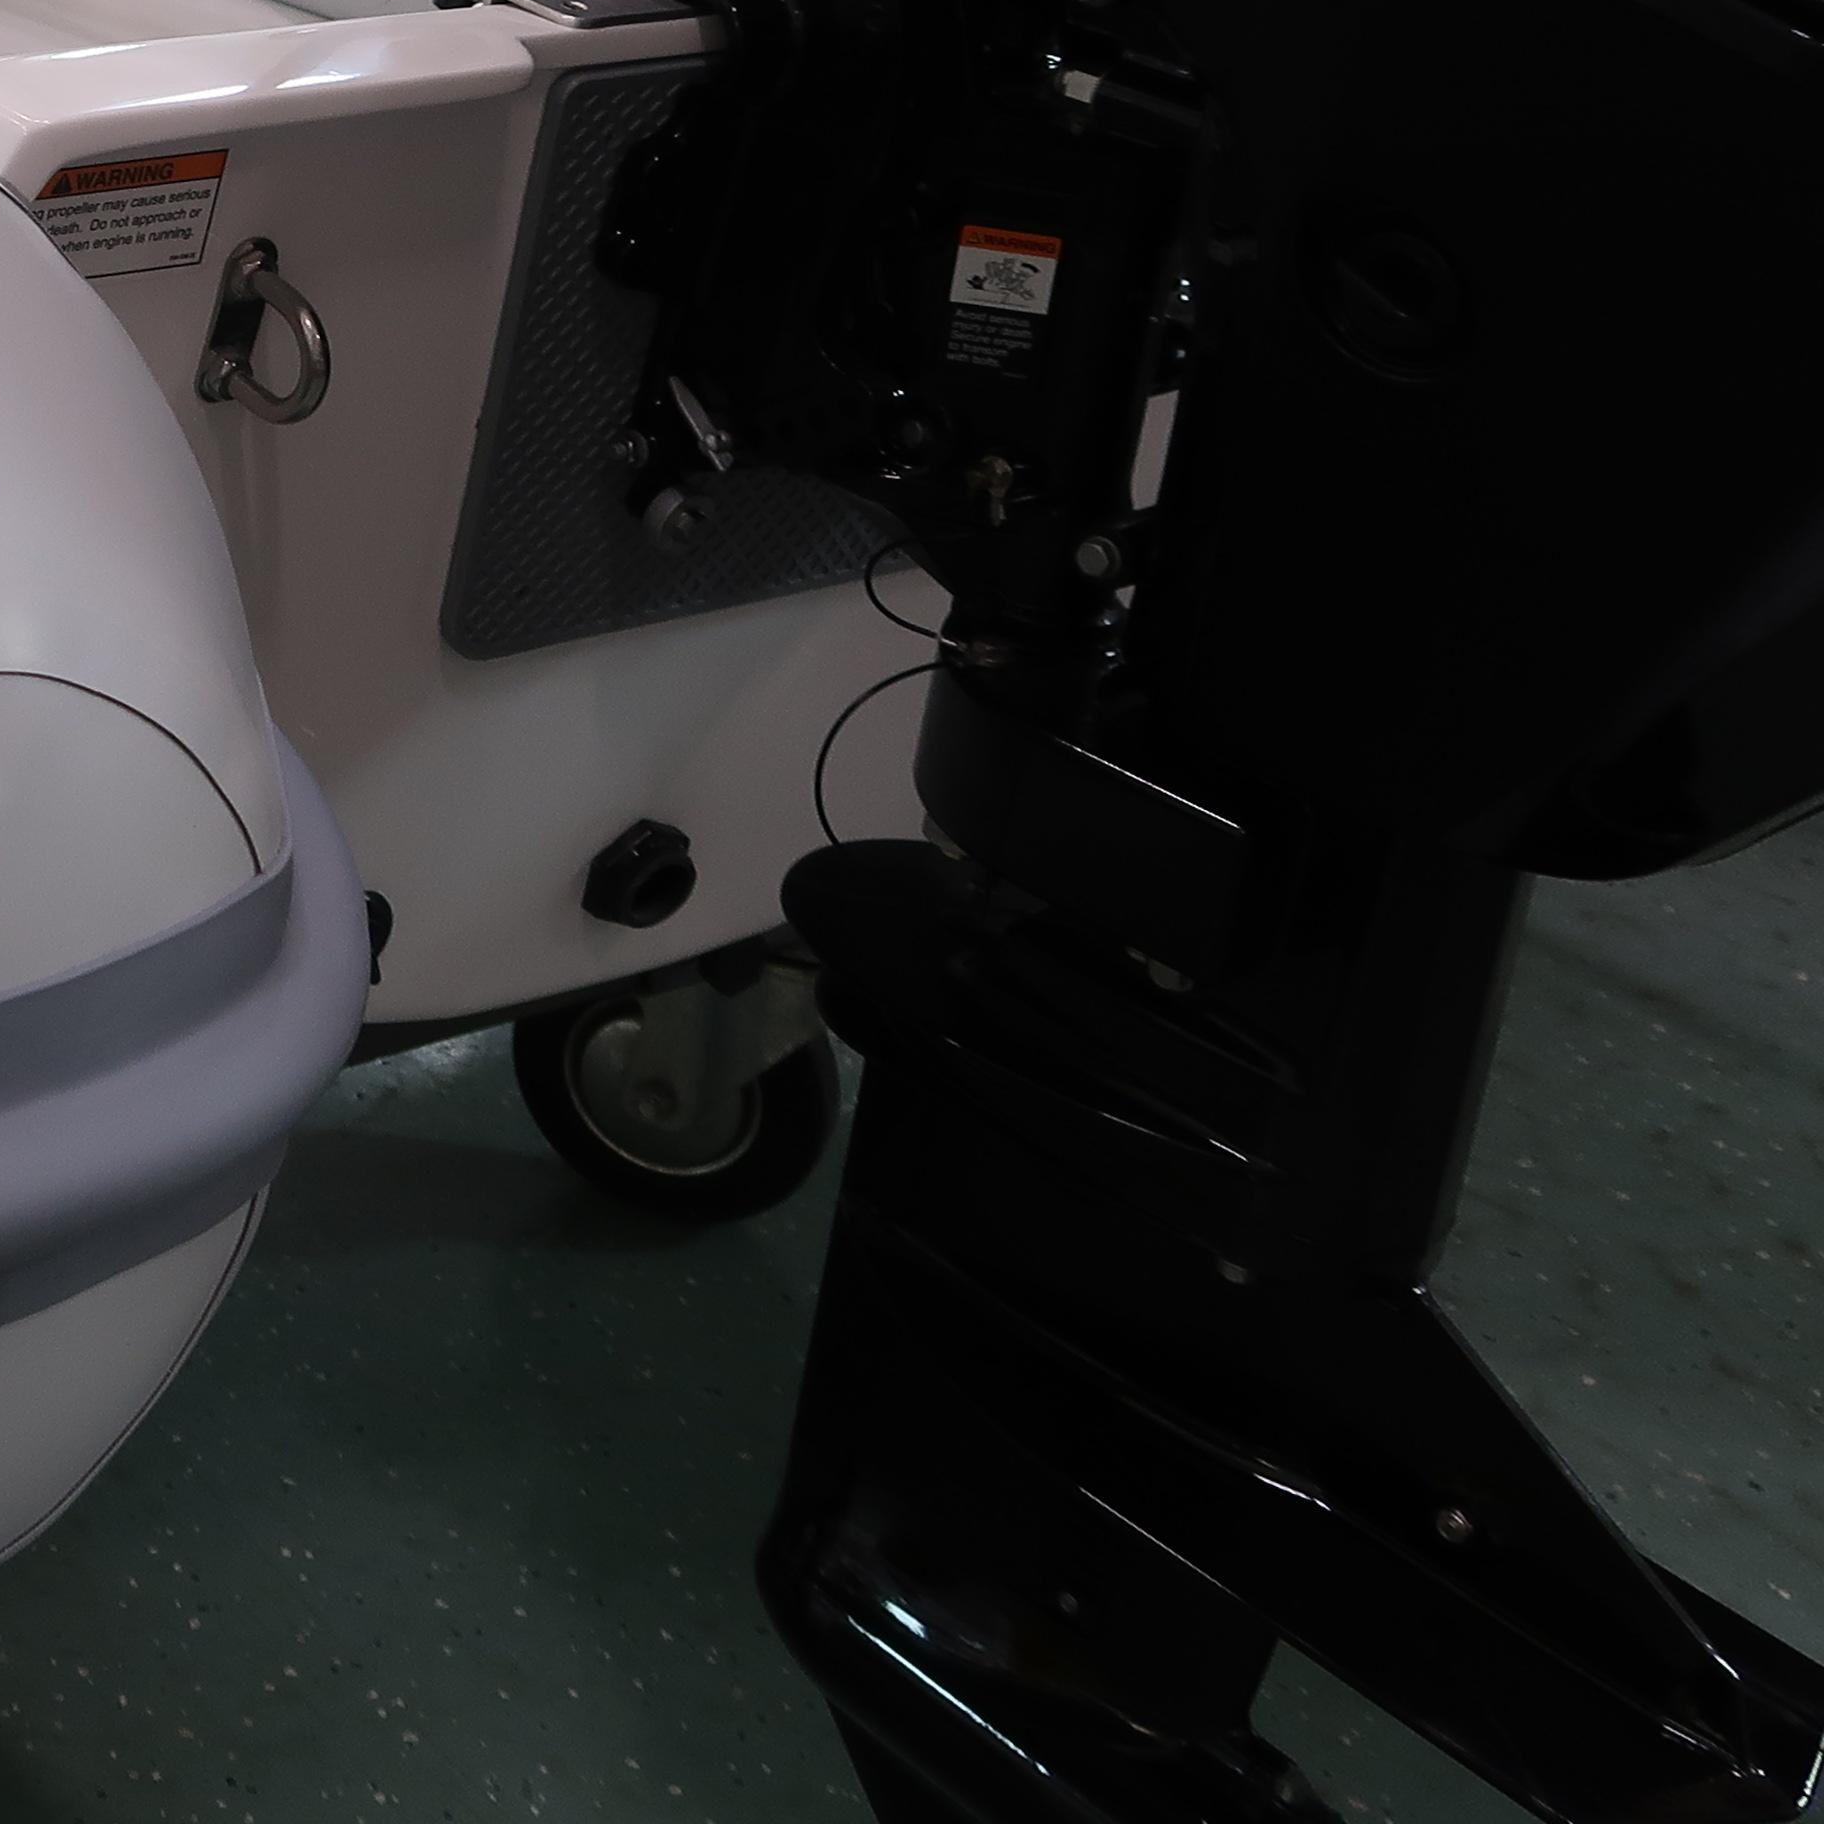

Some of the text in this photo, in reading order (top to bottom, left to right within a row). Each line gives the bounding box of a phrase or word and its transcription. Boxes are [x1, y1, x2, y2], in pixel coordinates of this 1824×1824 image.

[76, 162, 174, 190] WARNING
[47, 201, 101, 220] propeller
[102, 197, 127, 213] may
[131, 193, 166, 208] cause
[168, 188, 211, 203] serious
[90, 218, 108, 232] Do
[110, 215, 130, 228] not
[132, 209, 186, 229] approach
[188, 208, 203, 219] or
[93, 234, 133, 251] engine
[135, 232, 146, 243] is
[148, 226, 194, 245] running.
[983, 234, 1056, 254] WARNING
